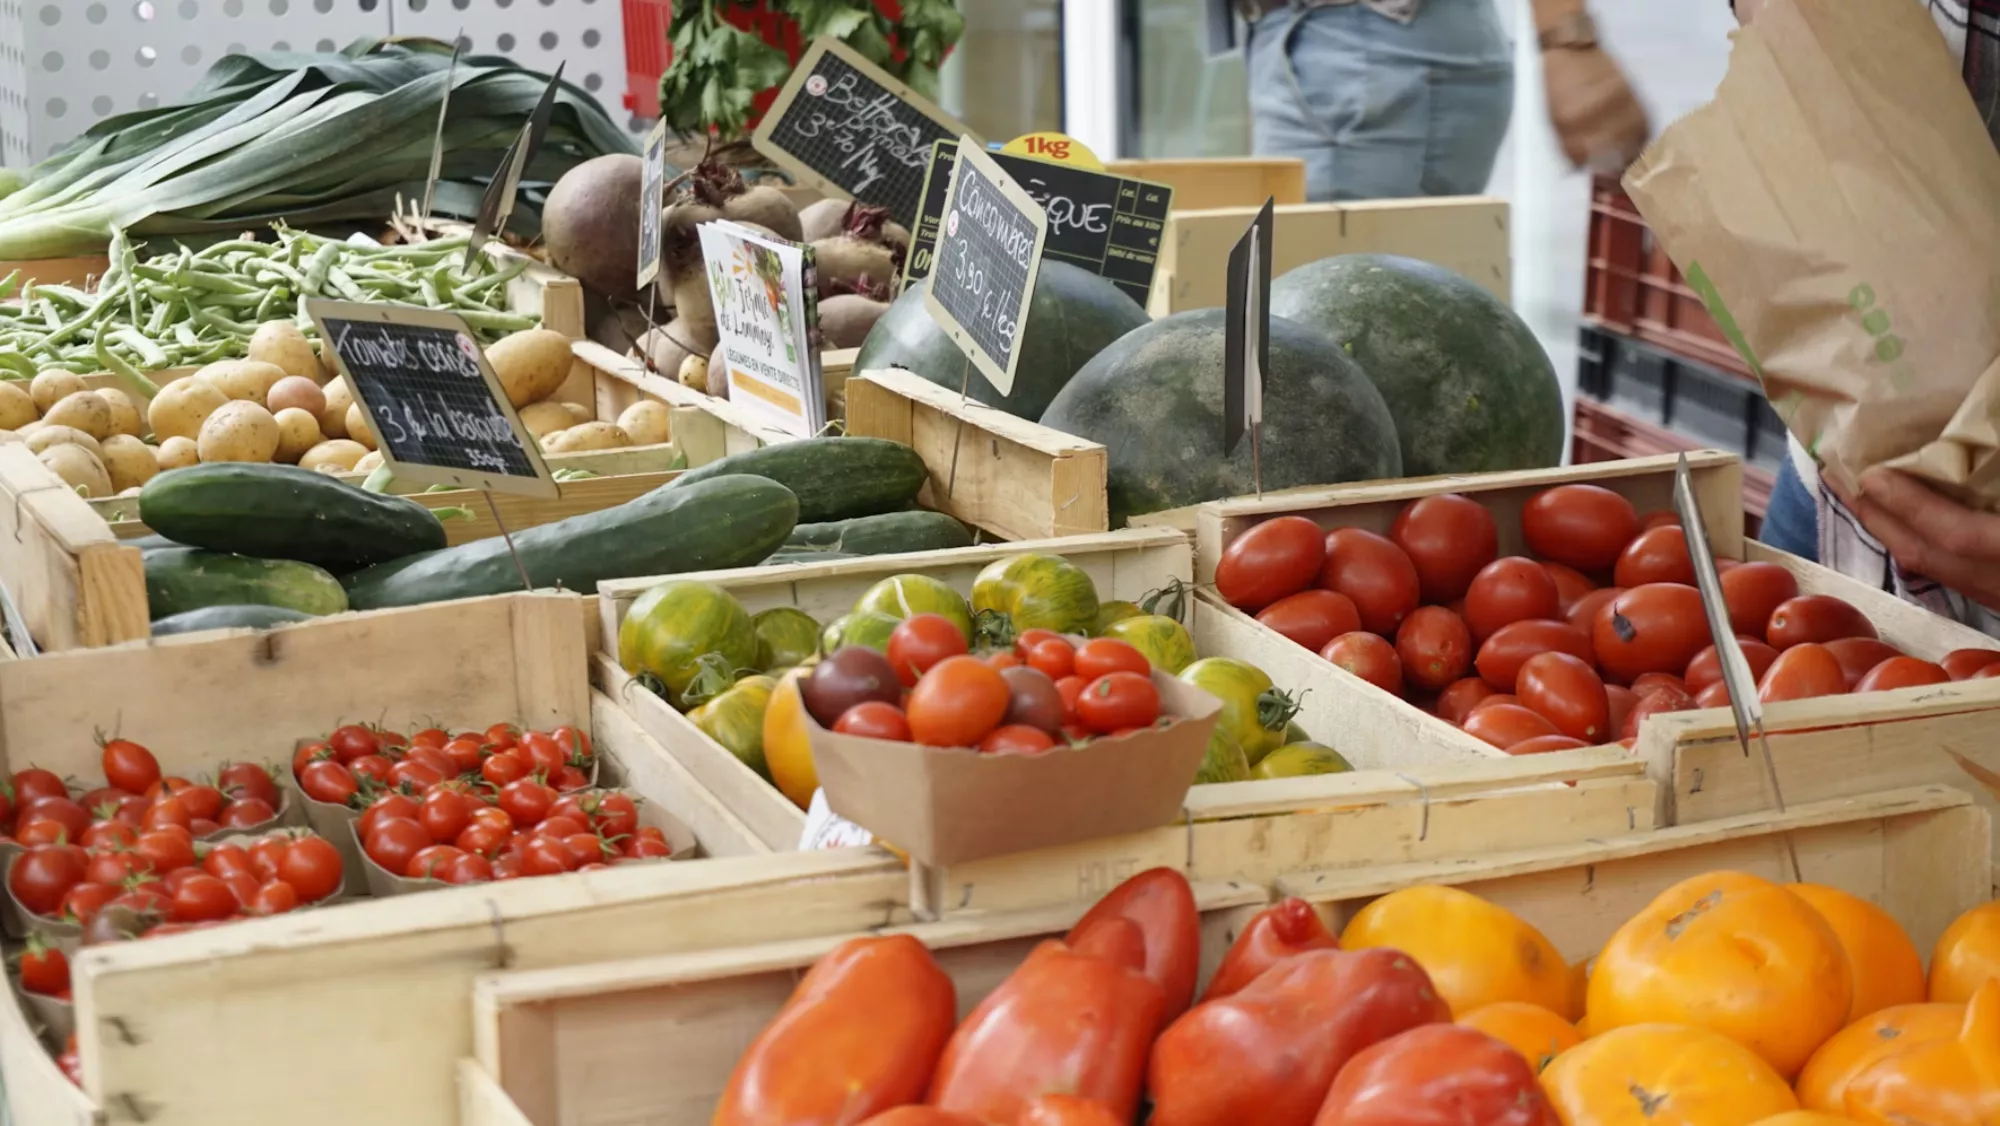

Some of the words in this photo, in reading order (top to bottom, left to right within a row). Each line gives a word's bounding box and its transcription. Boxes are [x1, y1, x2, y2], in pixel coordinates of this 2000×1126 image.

[1025, 136, 1071, 159] 1kg
[336, 323, 419, 370] Tomates
[379, 405, 407, 443] 3
